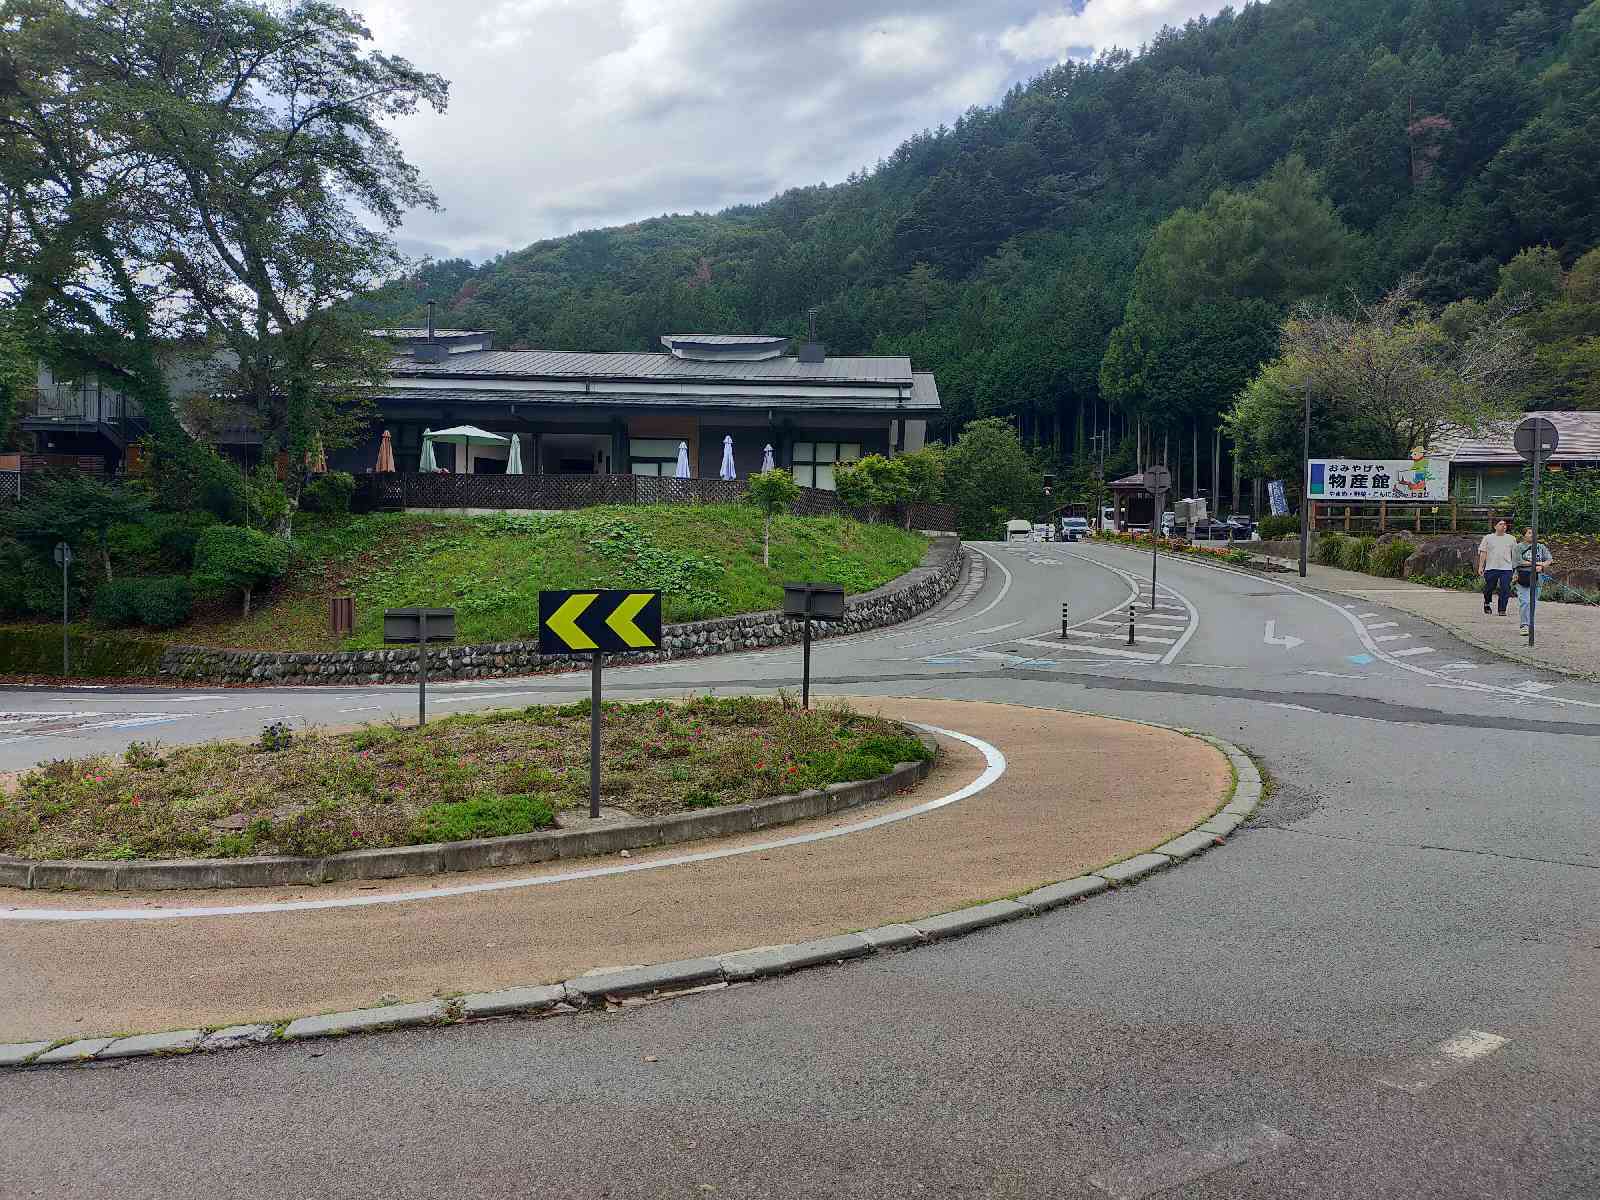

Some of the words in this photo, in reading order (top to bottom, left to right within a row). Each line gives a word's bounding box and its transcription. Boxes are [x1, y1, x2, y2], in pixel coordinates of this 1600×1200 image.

[1328, 464, 1385, 473] おみやげや
[1328, 473, 1391, 489] 物産館
